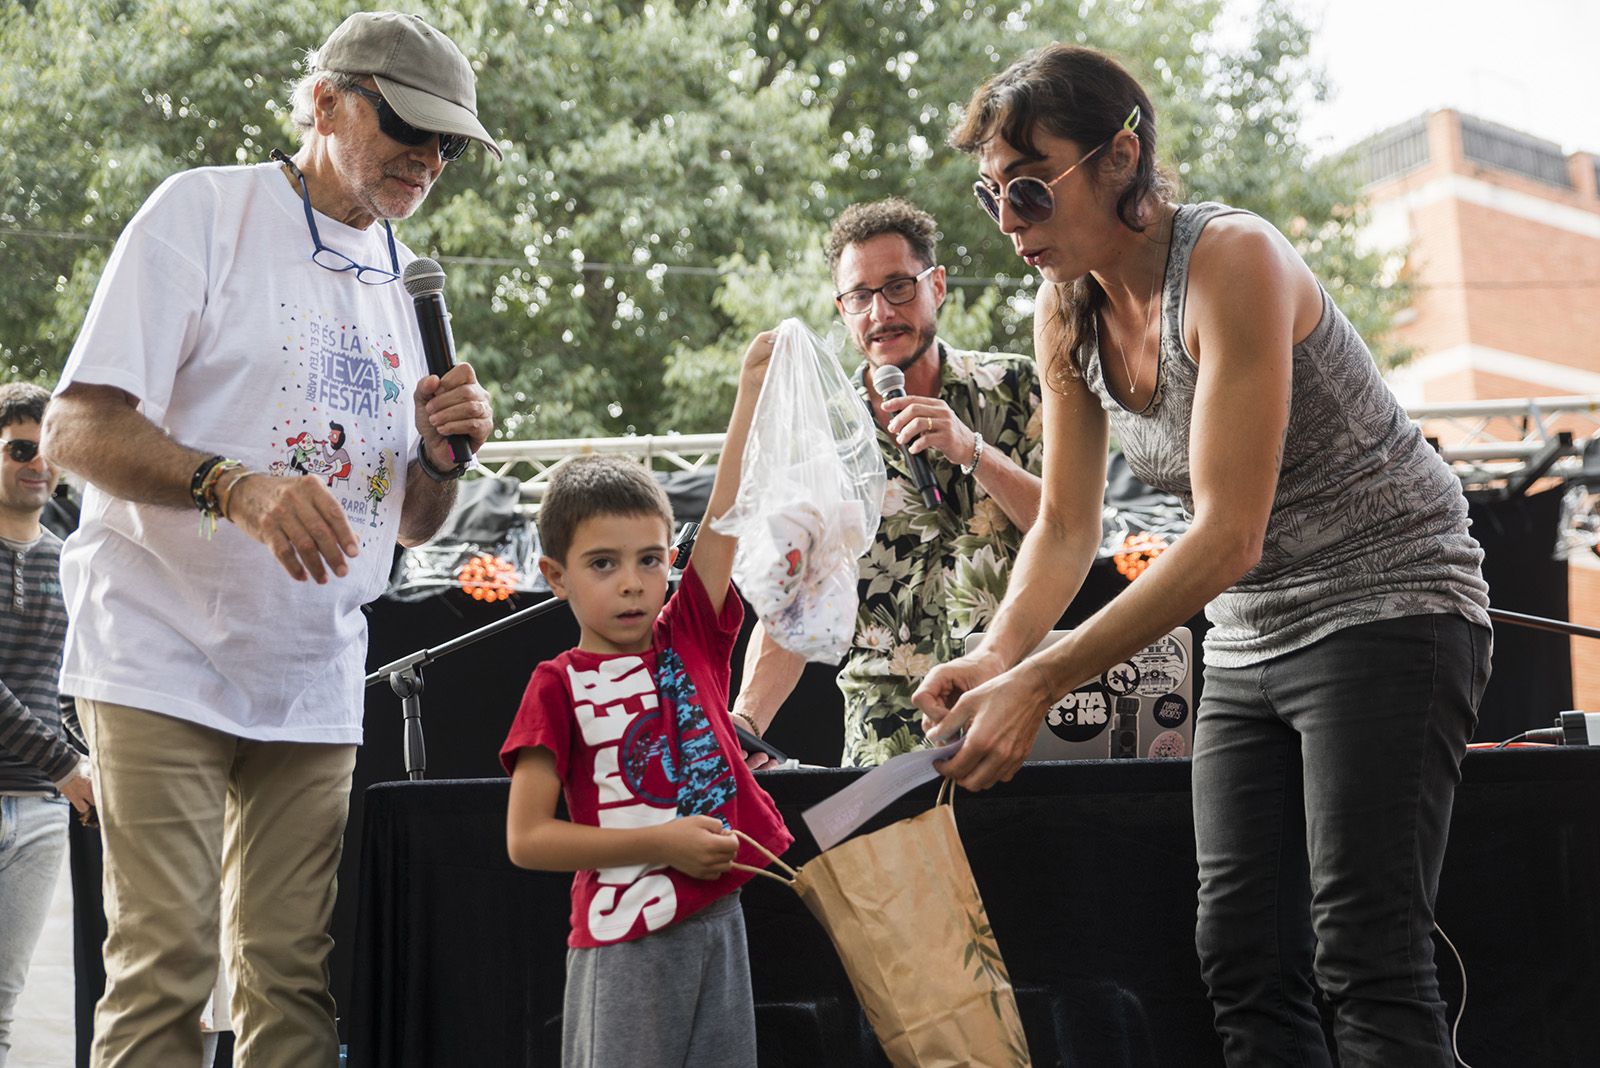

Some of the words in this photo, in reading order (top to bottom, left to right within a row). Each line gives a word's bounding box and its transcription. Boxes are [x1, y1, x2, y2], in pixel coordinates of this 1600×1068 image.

[310, 336, 320, 347] EL
[340, 332, 362, 354] LA
[309, 350, 319, 371] TEU
[321, 352, 377, 390] TEVA
[305, 372, 318, 402] BARRI
[319, 379, 380, 419] FESTA!
